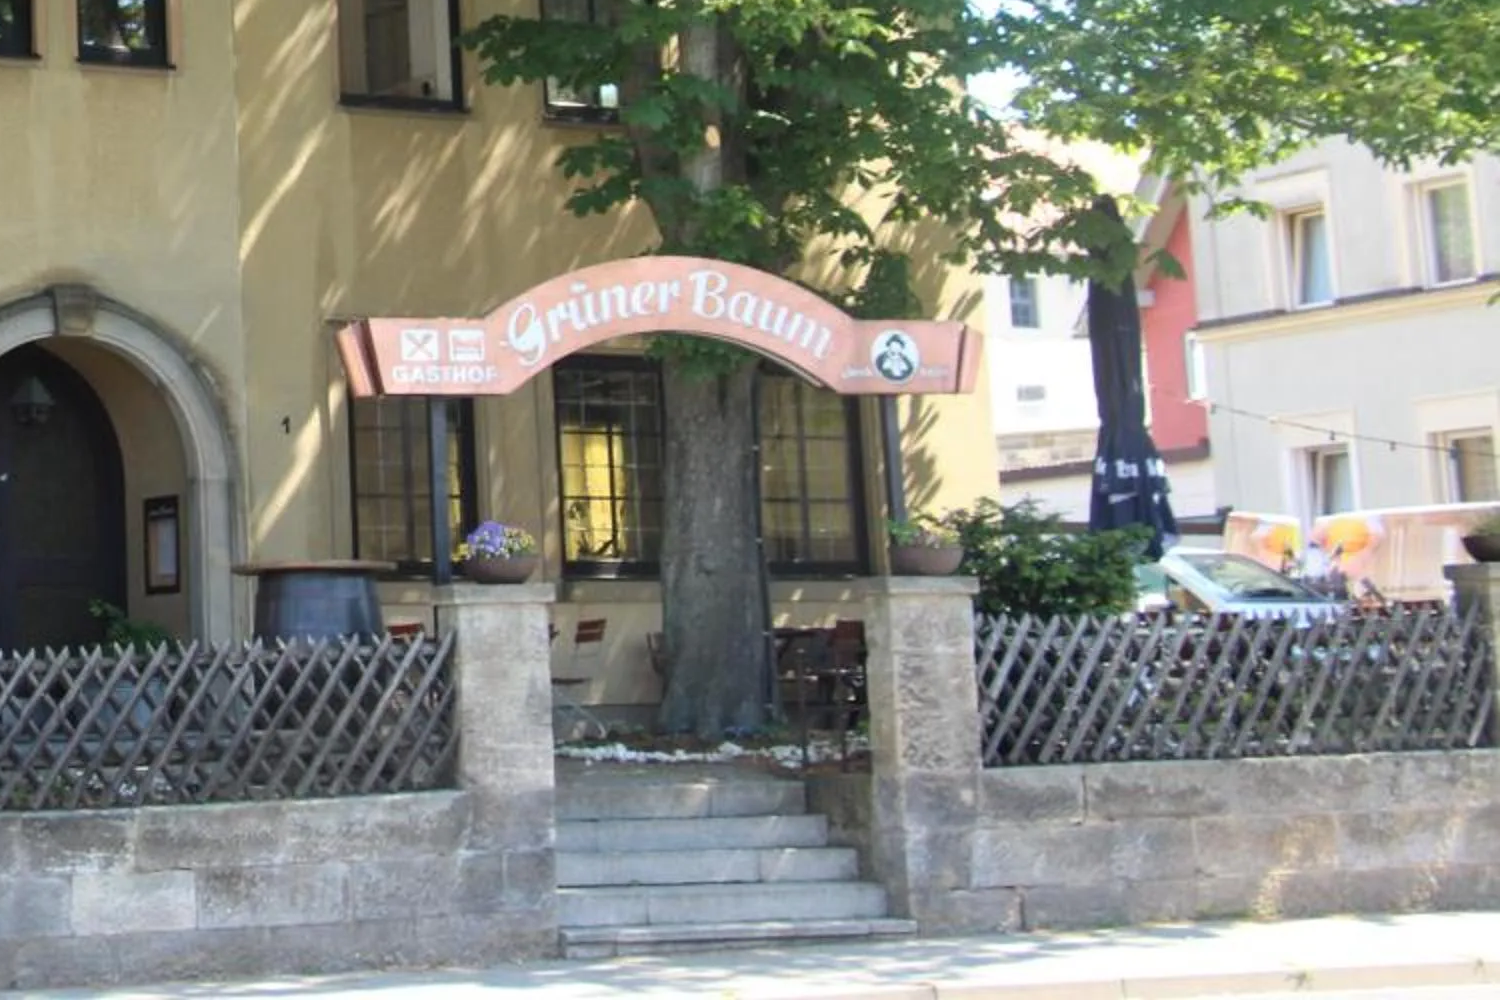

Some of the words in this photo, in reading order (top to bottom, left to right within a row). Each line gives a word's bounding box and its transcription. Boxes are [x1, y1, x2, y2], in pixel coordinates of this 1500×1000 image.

[503, 279, 682, 367] Grüner
[687, 269, 834, 360] Baum
[391, 364, 498, 384] GASTHOF
[281, 416, 290, 434] 1
